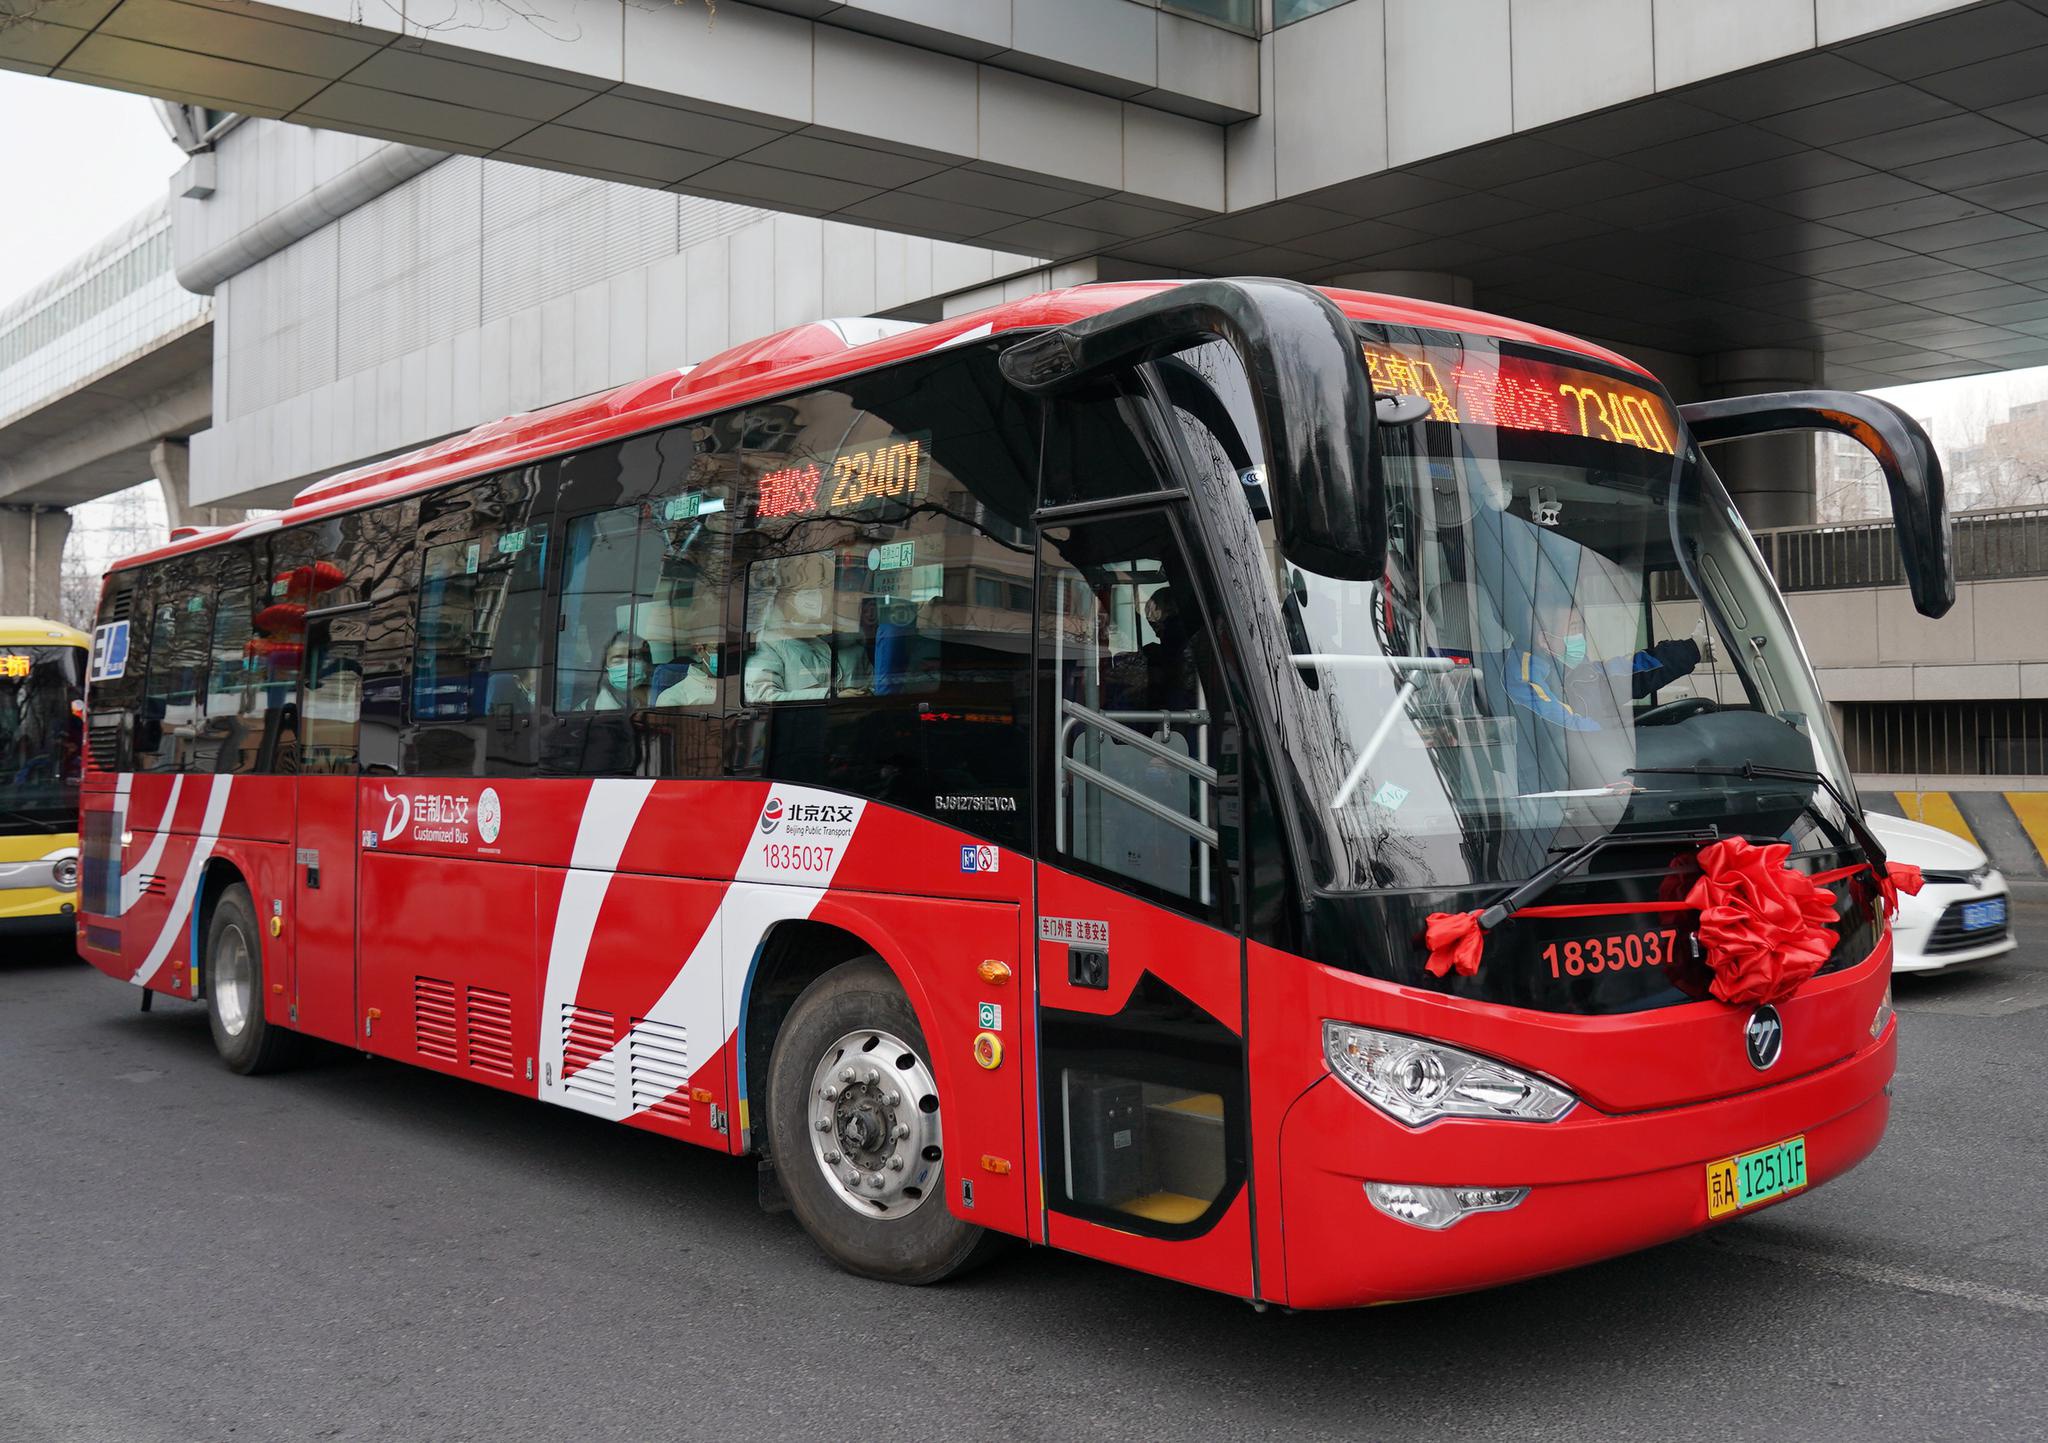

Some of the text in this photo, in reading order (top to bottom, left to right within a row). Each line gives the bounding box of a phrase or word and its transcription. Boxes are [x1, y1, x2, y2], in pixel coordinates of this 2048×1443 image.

[831, 440, 919, 507] 23401
[413, 794, 469, 824] 定制公交
[787, 804, 854, 823] 北京公交
[413, 825, 469, 844] Customized Bus
[786, 825, 851, 838] Beijing Public Transport
[763, 844, 834, 872] 1835037
[1076, 921, 1107, 941] 注意安全
[1542, 929, 1677, 978] 1835037
